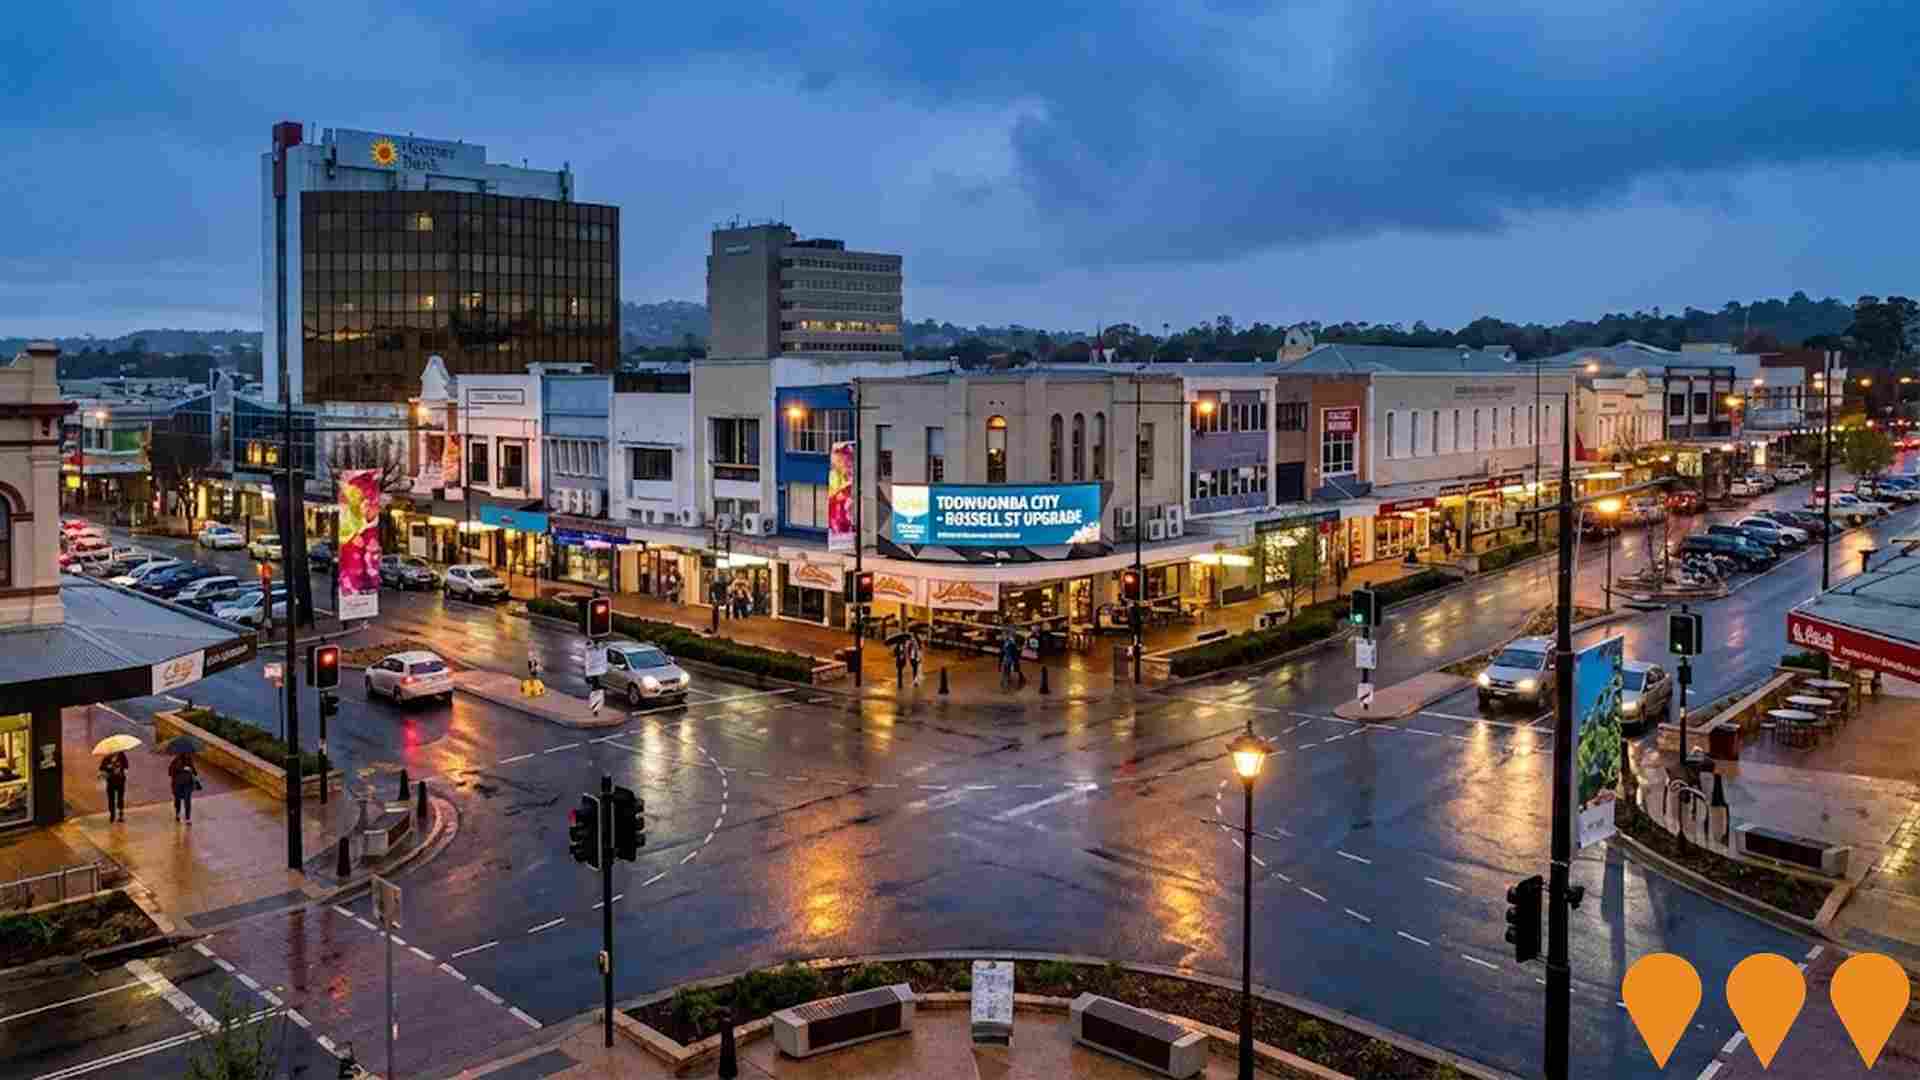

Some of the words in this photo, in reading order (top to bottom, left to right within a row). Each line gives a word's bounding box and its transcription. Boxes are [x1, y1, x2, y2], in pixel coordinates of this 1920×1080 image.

[1031, 494, 1060, 510] CITY
[1004, 511, 1022, 527] ST
[1024, 508, 1083, 527] UPGRADE
